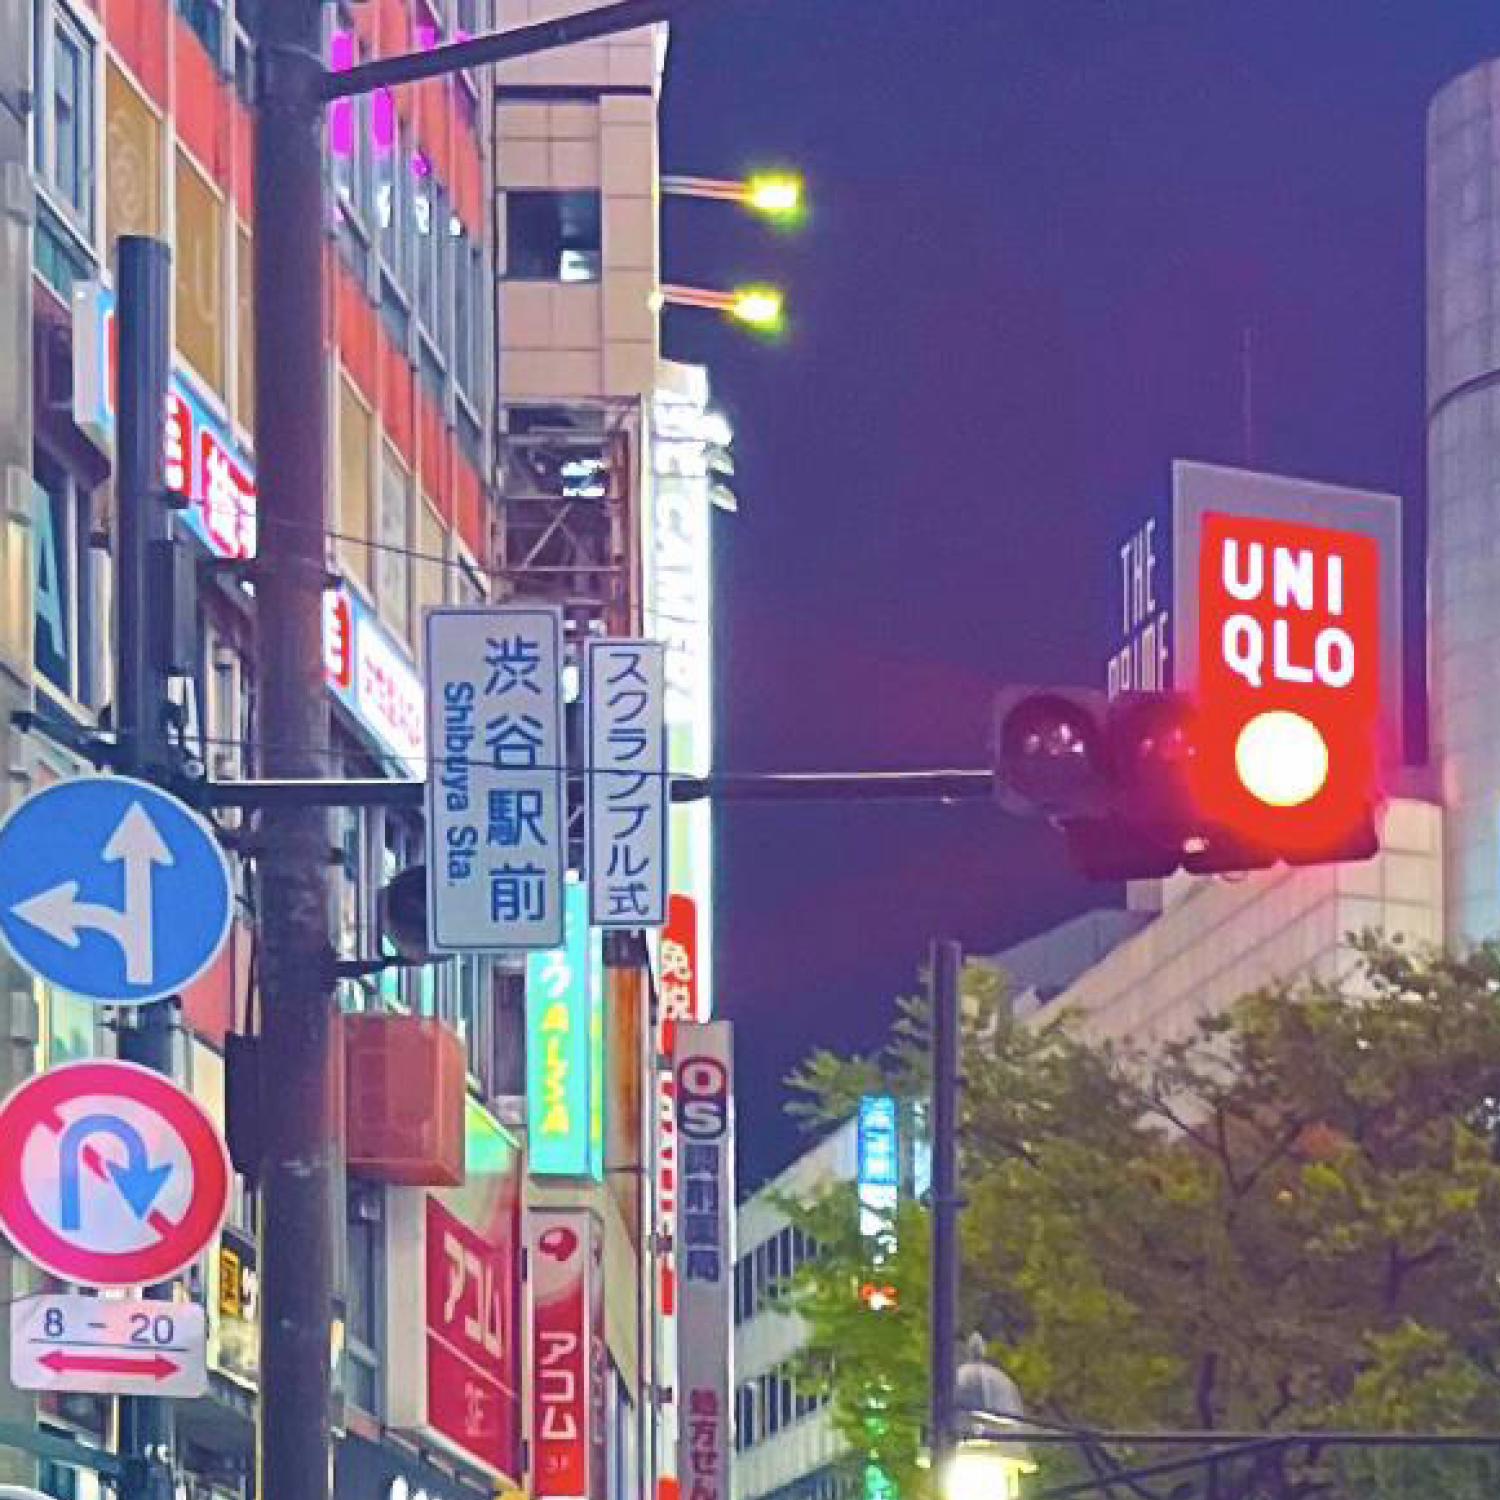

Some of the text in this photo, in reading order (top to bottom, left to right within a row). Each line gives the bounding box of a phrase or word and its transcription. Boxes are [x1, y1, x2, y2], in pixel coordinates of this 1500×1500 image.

[1121, 517, 1156, 636] THE
[1222, 537, 1344, 616] UNI
[1222, 613, 1355, 689] QLO
[442, 681, 478, 886] Shibuya Sta.
[484, 634, 548, 923] 渋谷駅前
[679, 1058, 727, 1138] OS
[44, 1308, 64, 1336] 8
[129, 1312, 174, 1344] 20
[443, 1230, 504, 1361] アコム
[539, 1332, 577, 1441] アコム
